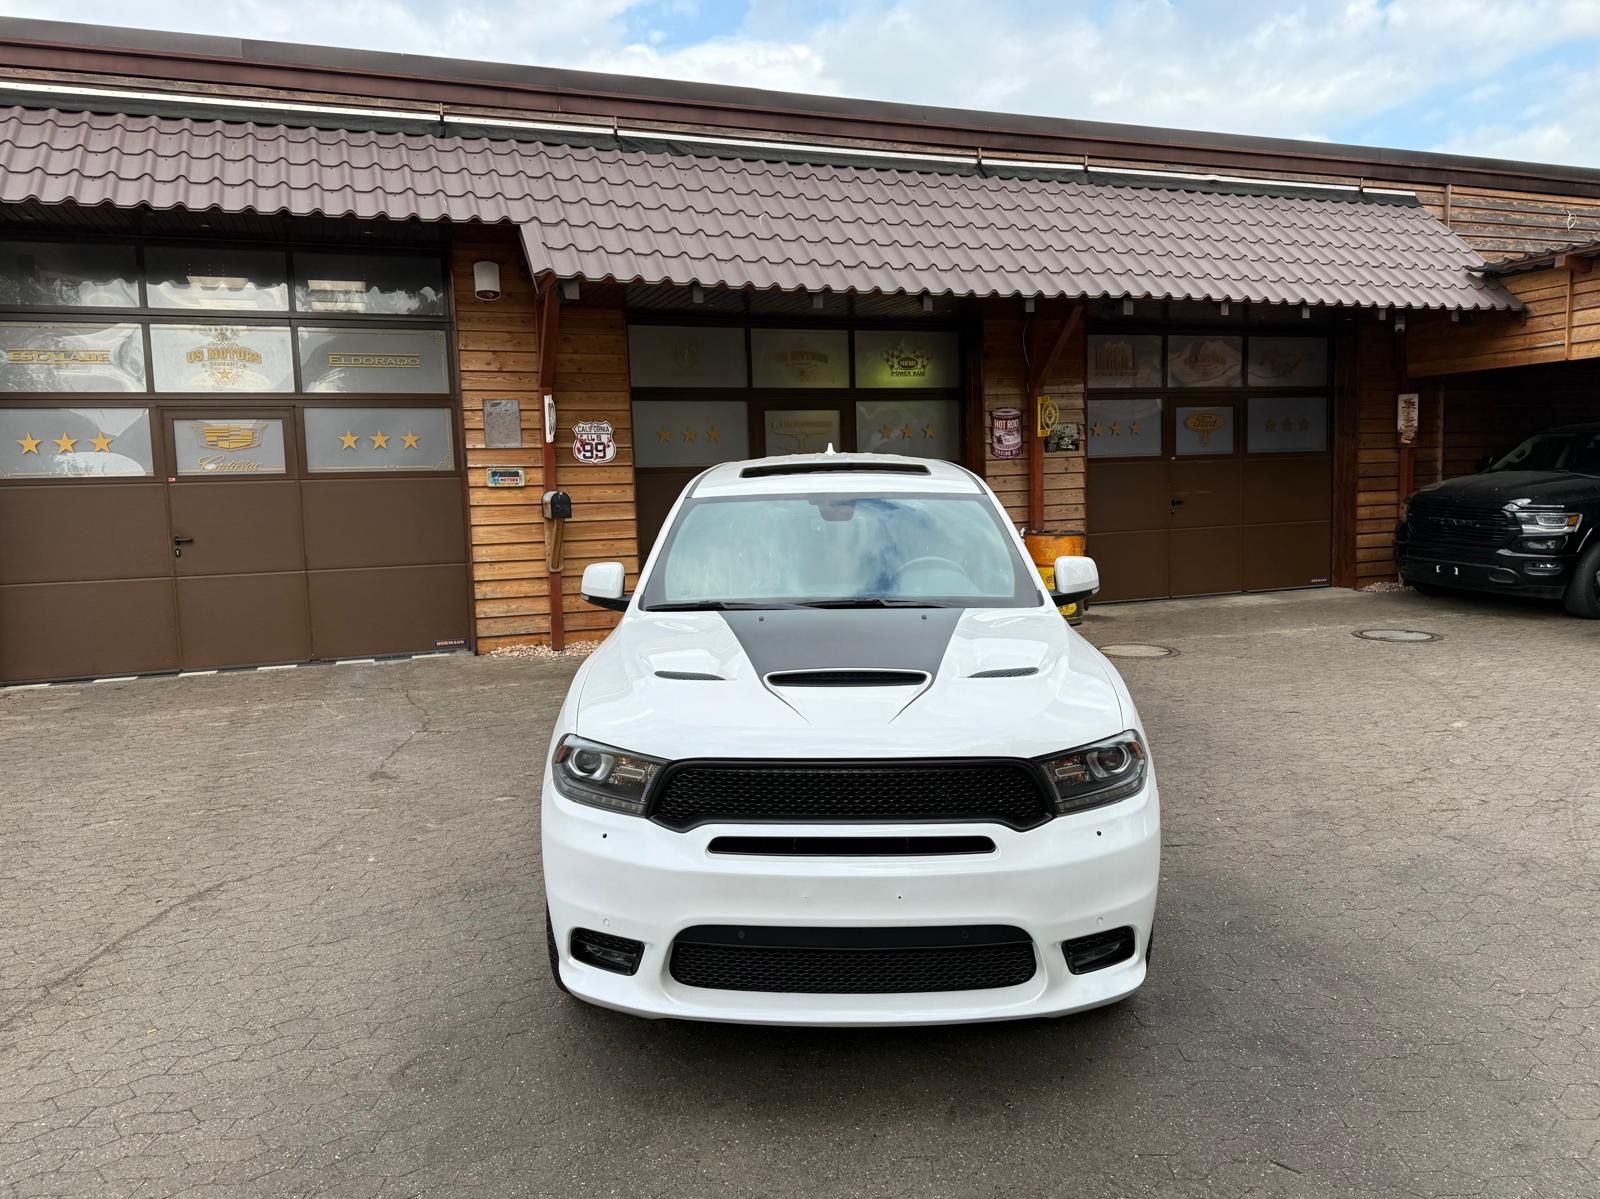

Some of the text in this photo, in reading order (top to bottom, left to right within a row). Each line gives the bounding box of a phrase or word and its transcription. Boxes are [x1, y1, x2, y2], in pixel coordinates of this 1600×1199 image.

[187, 347, 263, 364] US MOTORS
[329, 355, 420, 365] ELDORADO
[577, 425, 610, 433] CALIFORNIA
[994, 419, 1019, 429] HOT ROD
[582, 442, 606, 459] 99
[198, 455, 261, 472] Cadillac
